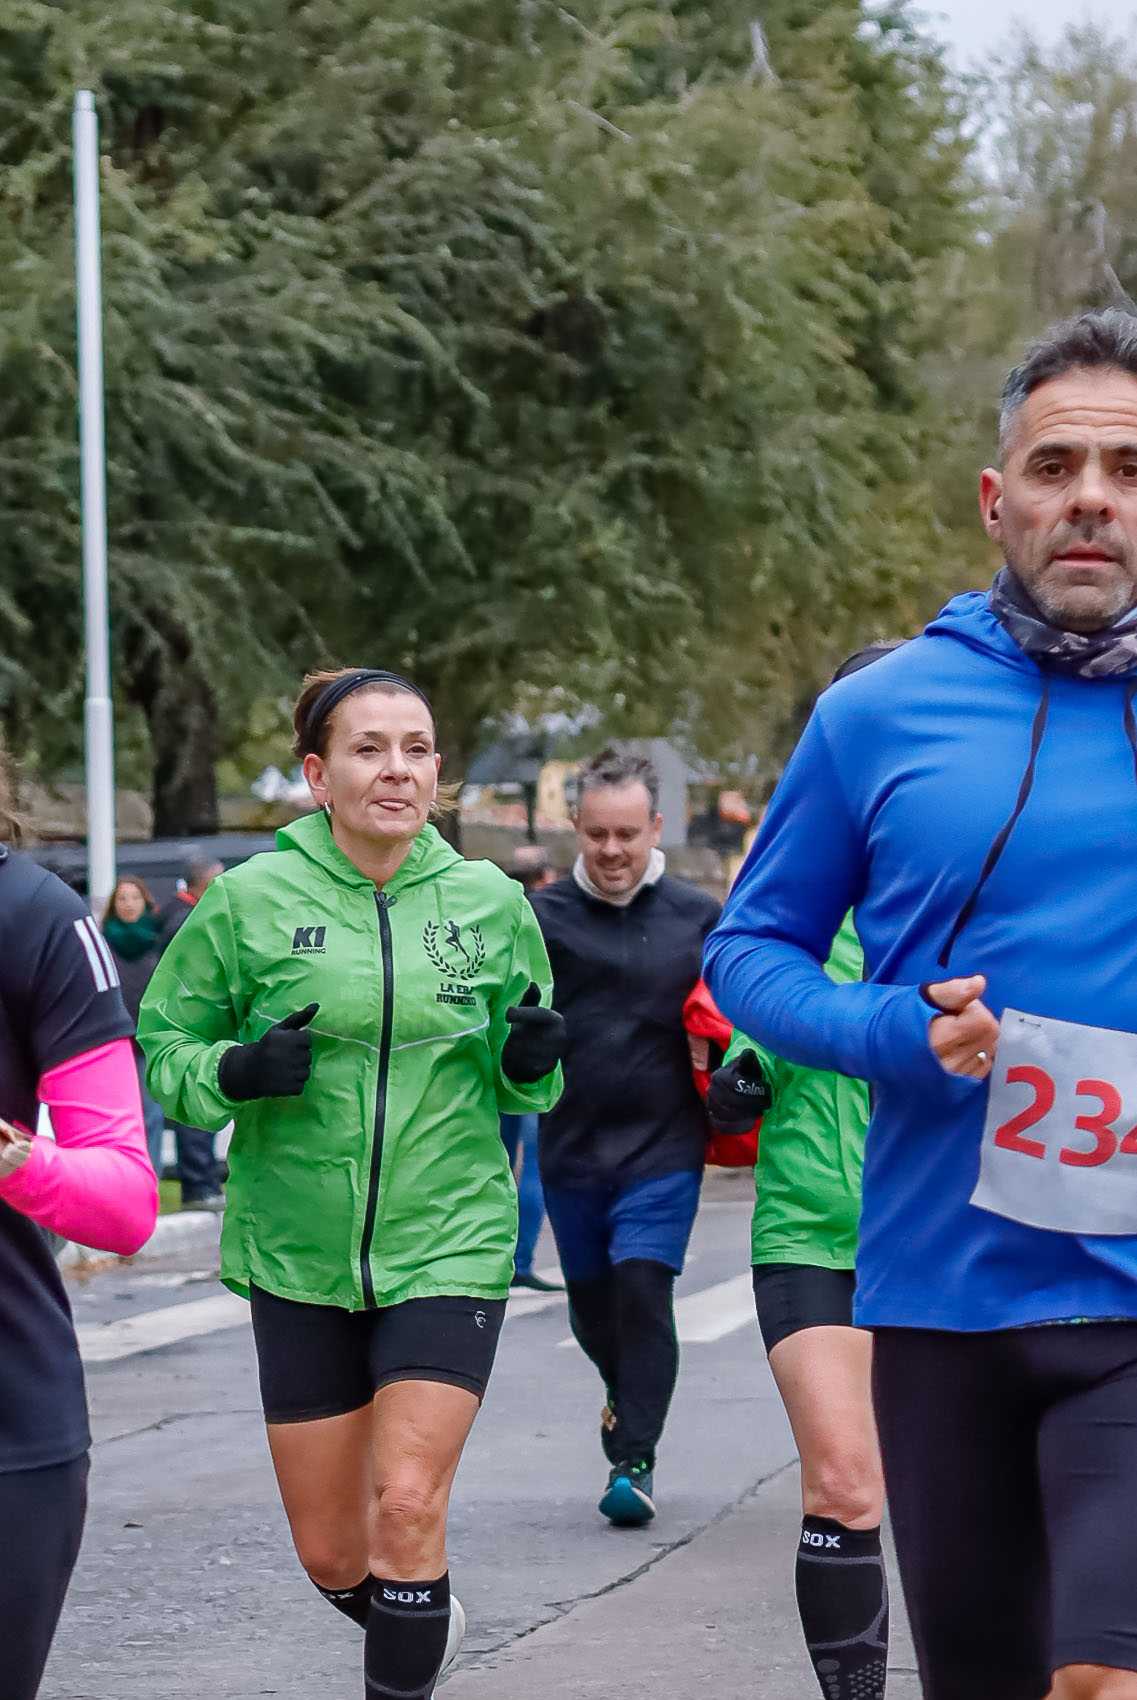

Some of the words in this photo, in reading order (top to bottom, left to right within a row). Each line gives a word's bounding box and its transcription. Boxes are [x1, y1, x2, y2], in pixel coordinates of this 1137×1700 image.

[291, 948, 326, 956] RUNNING
[440, 983, 455, 993] LA
[436, 993, 476, 1006] RUNNING
[801, 1530, 841, 1549] SOX
[383, 1588, 431, 1603] SOX
